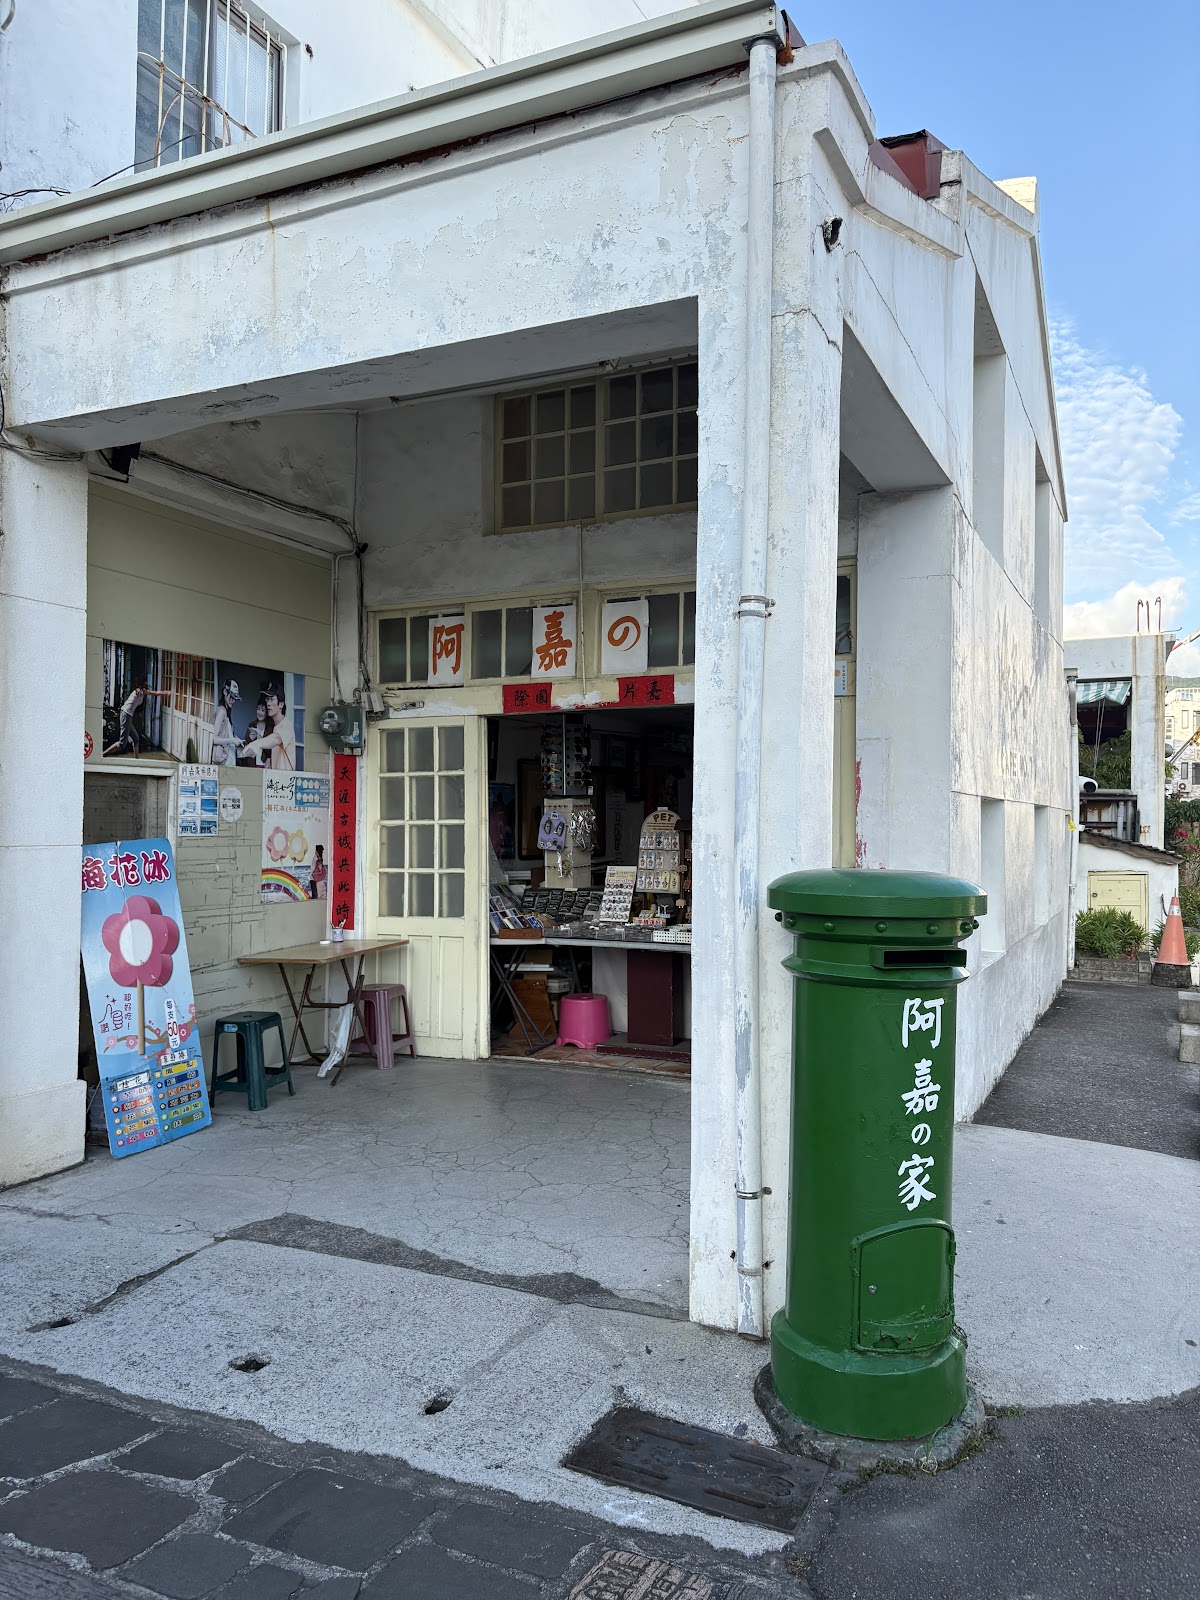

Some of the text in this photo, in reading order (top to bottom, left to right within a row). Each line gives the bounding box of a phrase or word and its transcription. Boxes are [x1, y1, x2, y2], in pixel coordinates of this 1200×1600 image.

[653, 813, 674, 822] PET
[897, 997, 945, 1212] 阿嘉の家
